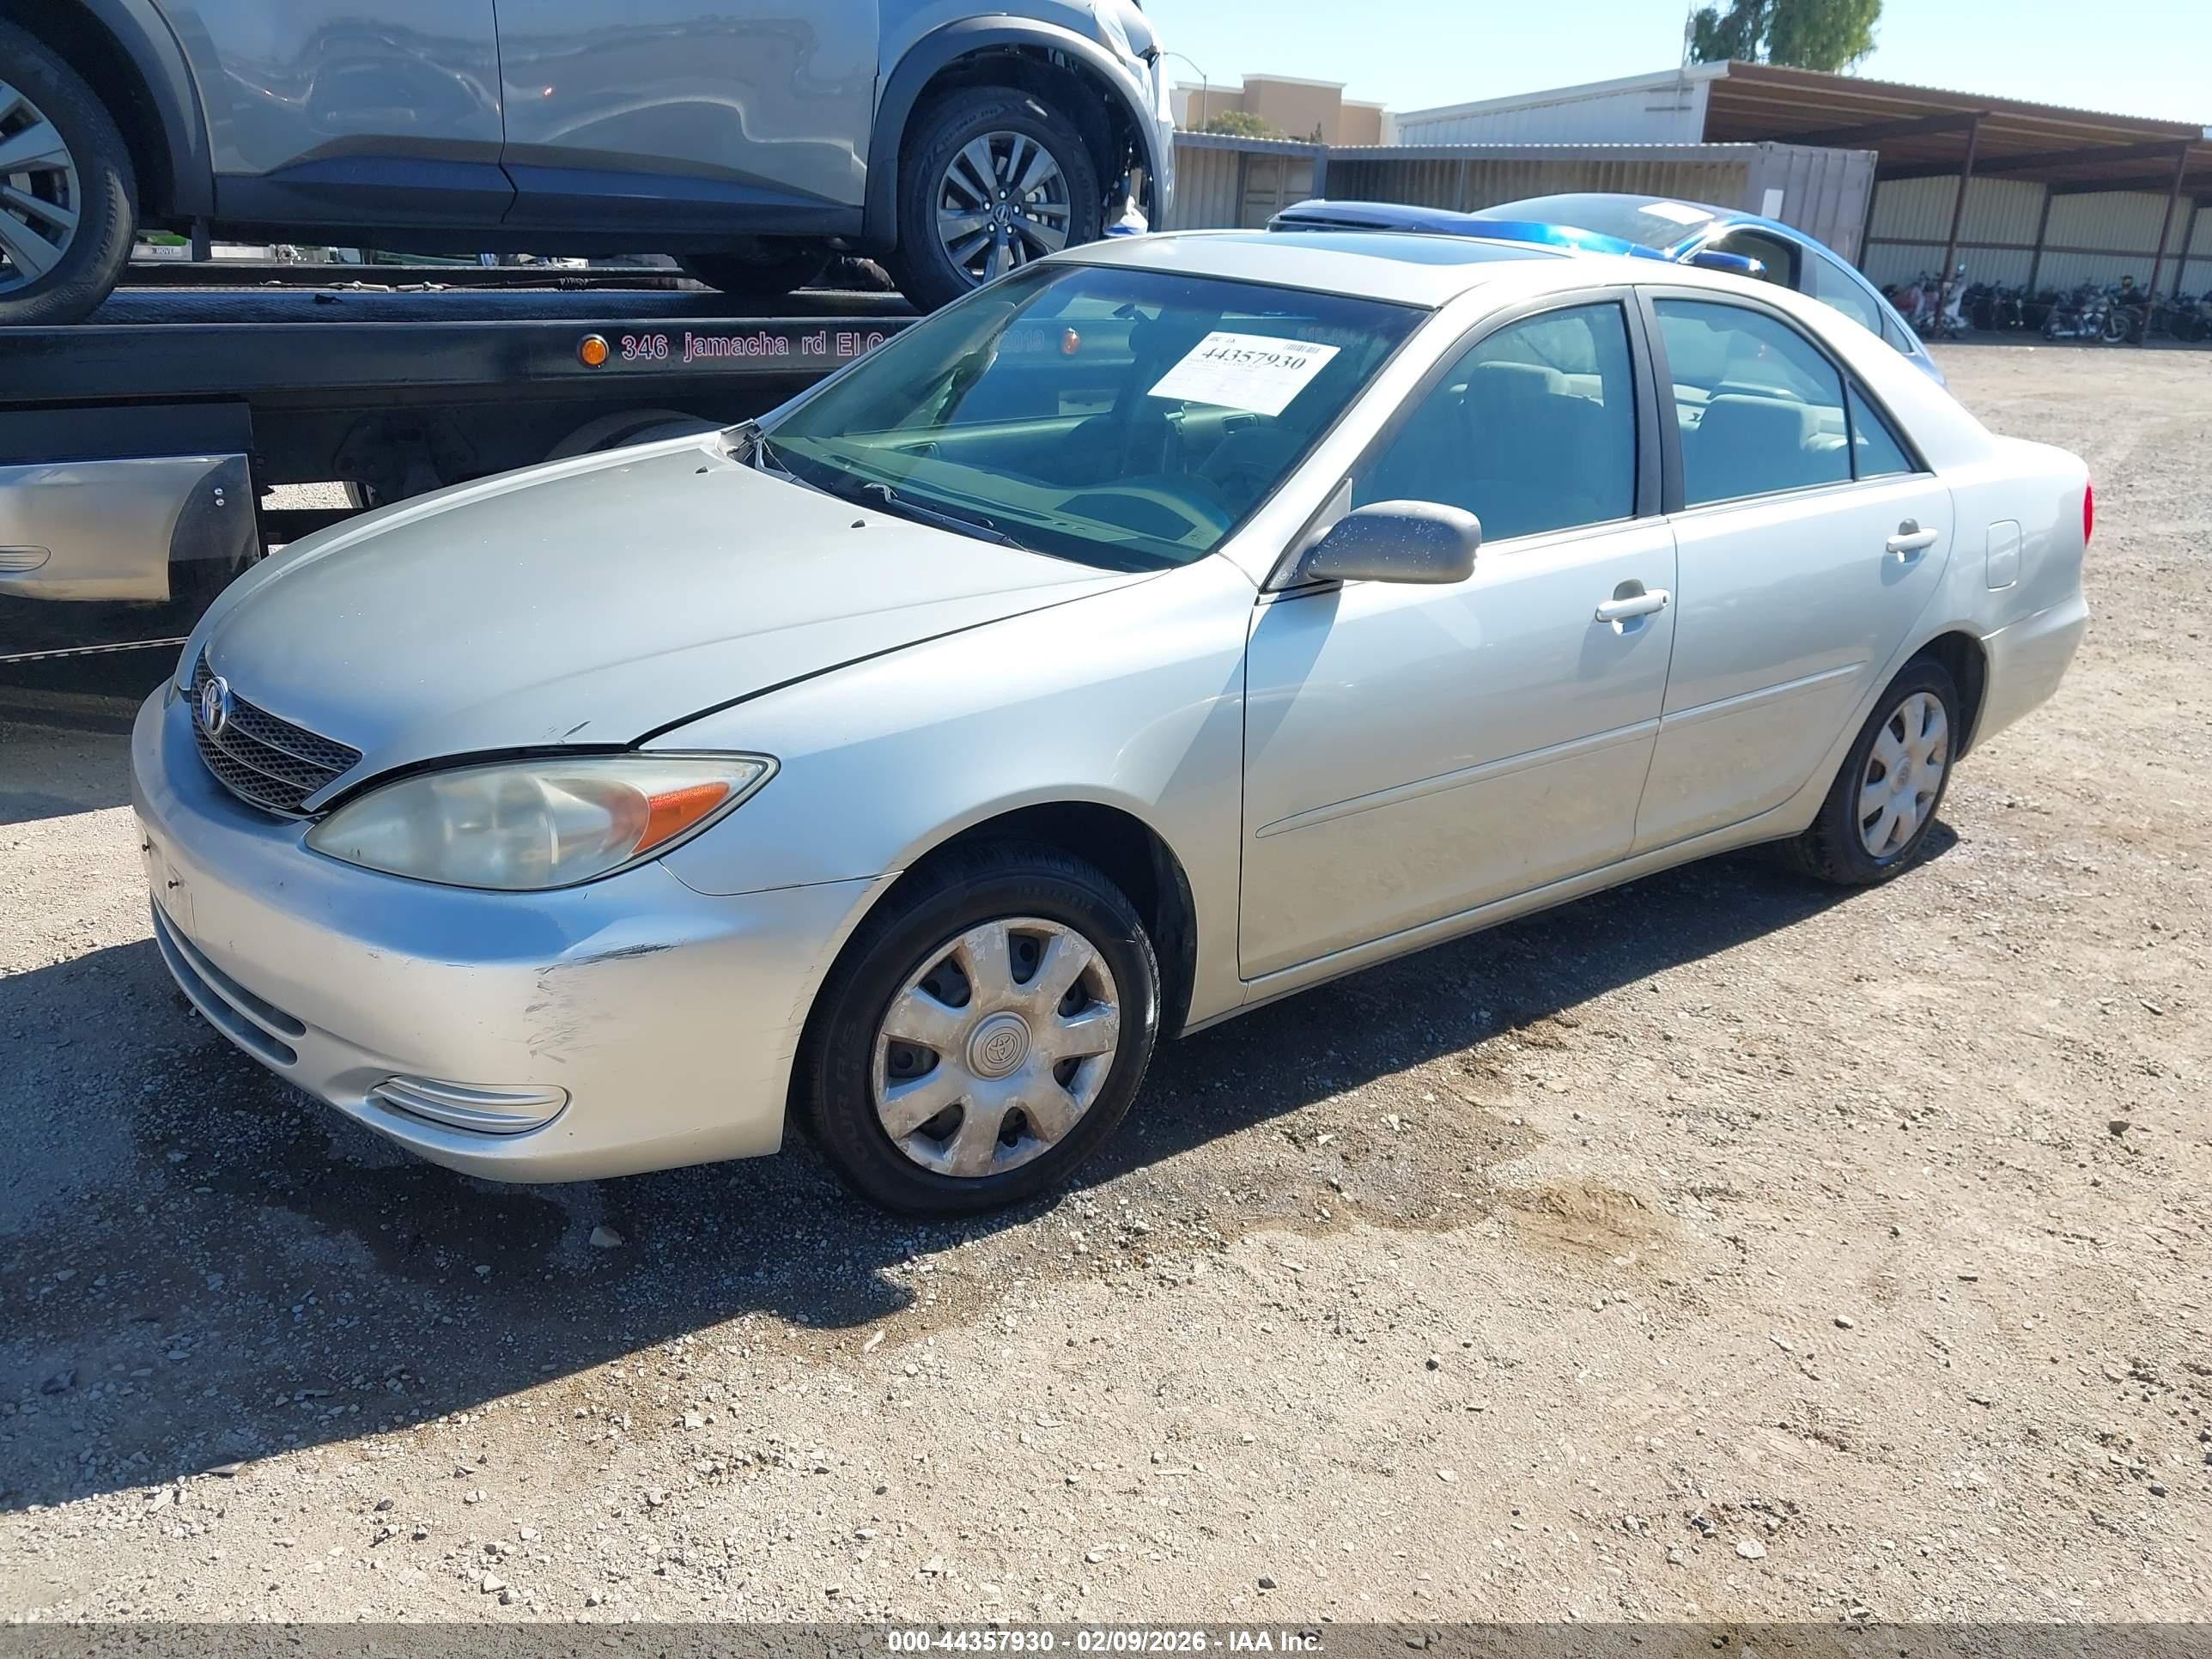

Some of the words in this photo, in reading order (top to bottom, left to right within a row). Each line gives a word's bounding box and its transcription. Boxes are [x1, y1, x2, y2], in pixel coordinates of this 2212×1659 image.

[621, 335, 668, 359] 346
[684, 332, 789, 362] jamacha
[802, 331, 825, 355] rd
[836, 331, 860, 356] El
[1202, 347, 1308, 370] 44357930
